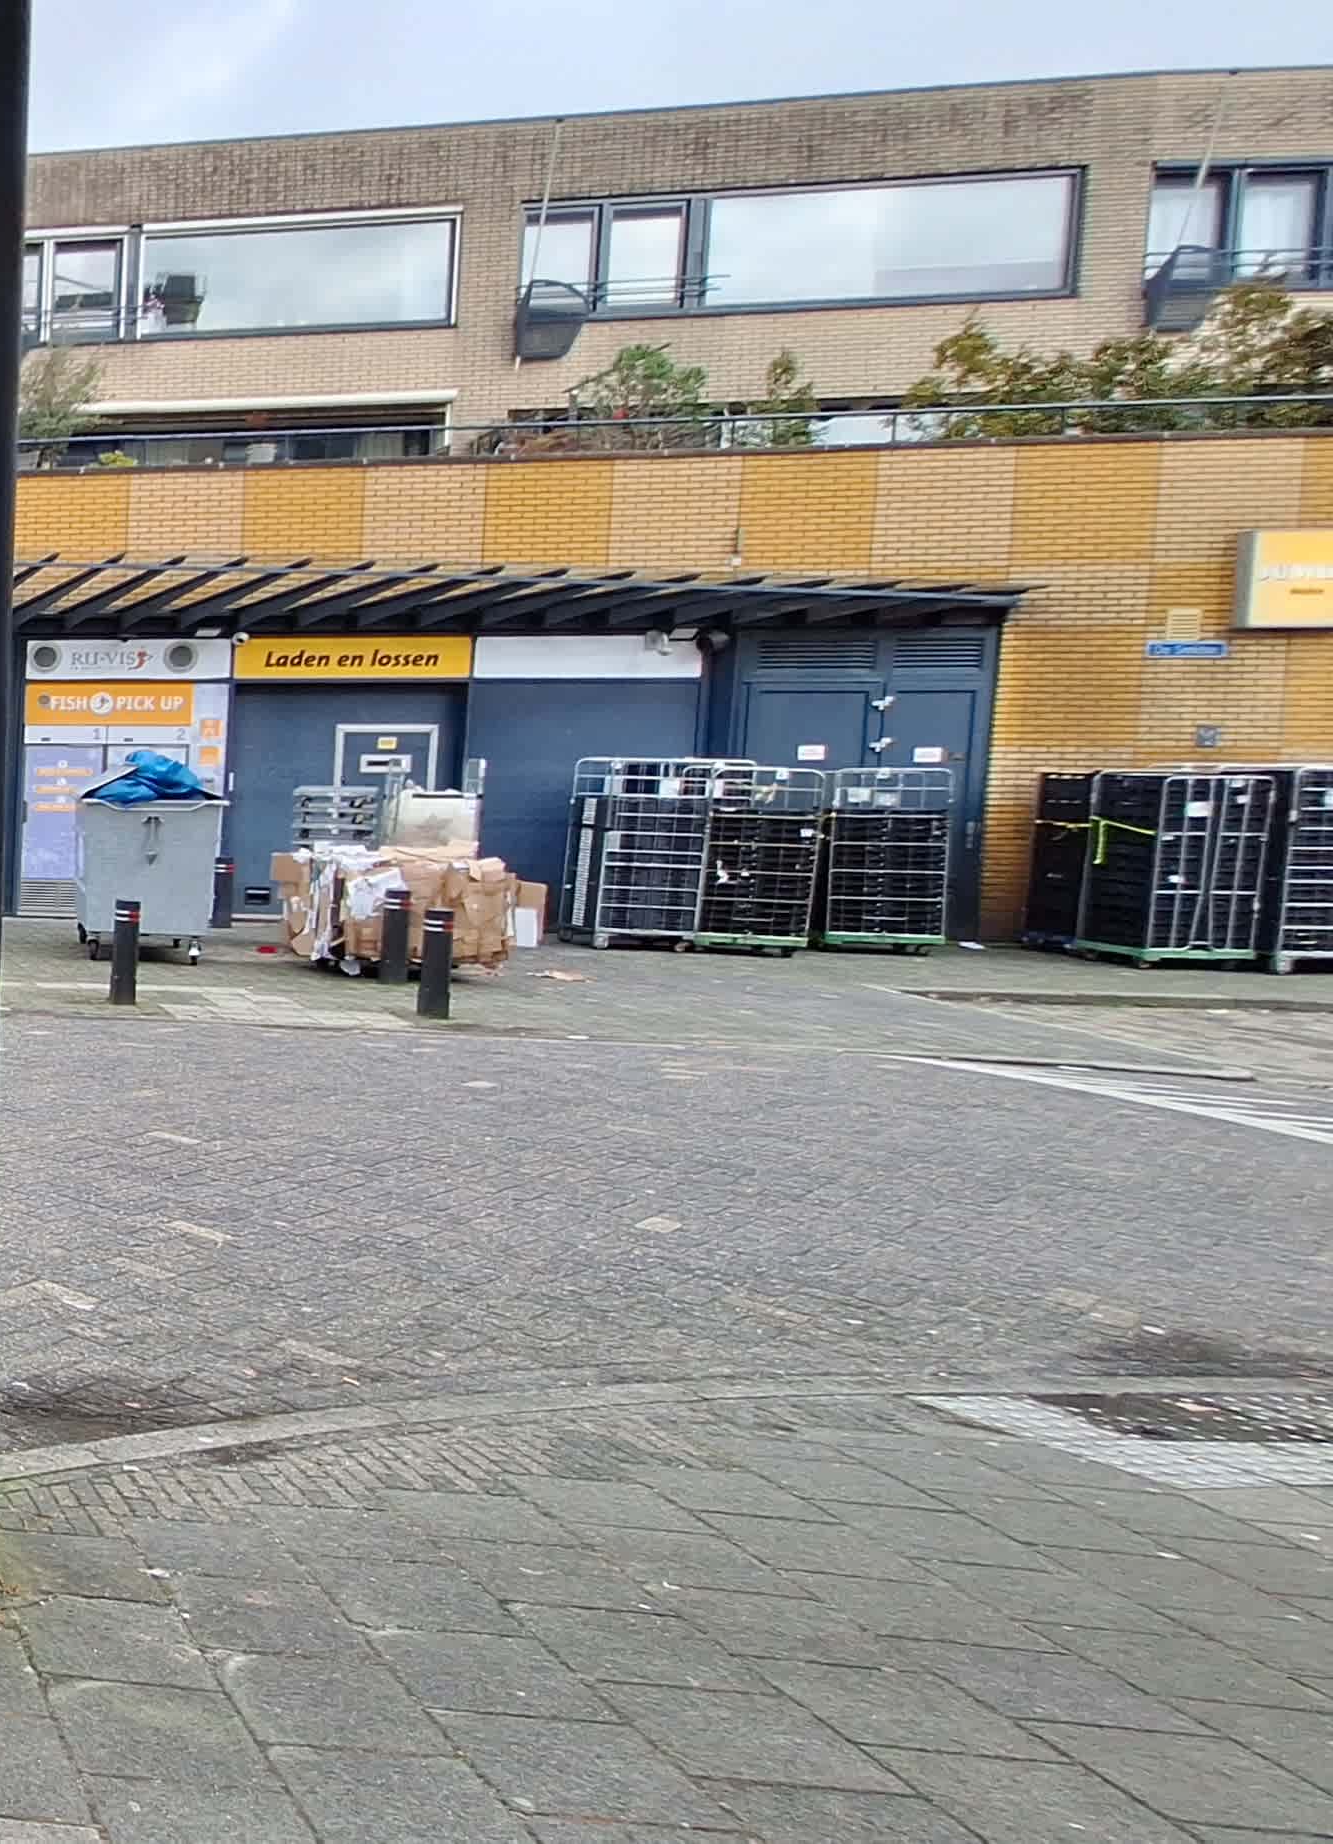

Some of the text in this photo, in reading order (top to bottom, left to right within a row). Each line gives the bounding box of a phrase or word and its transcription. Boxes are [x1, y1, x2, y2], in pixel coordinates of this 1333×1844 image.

[265, 649, 439, 667] Laden en lossen
[50, 695, 184, 711] FISH PICK UP
[93, 728, 101, 739] 1
[177, 728, 186, 740] 2
